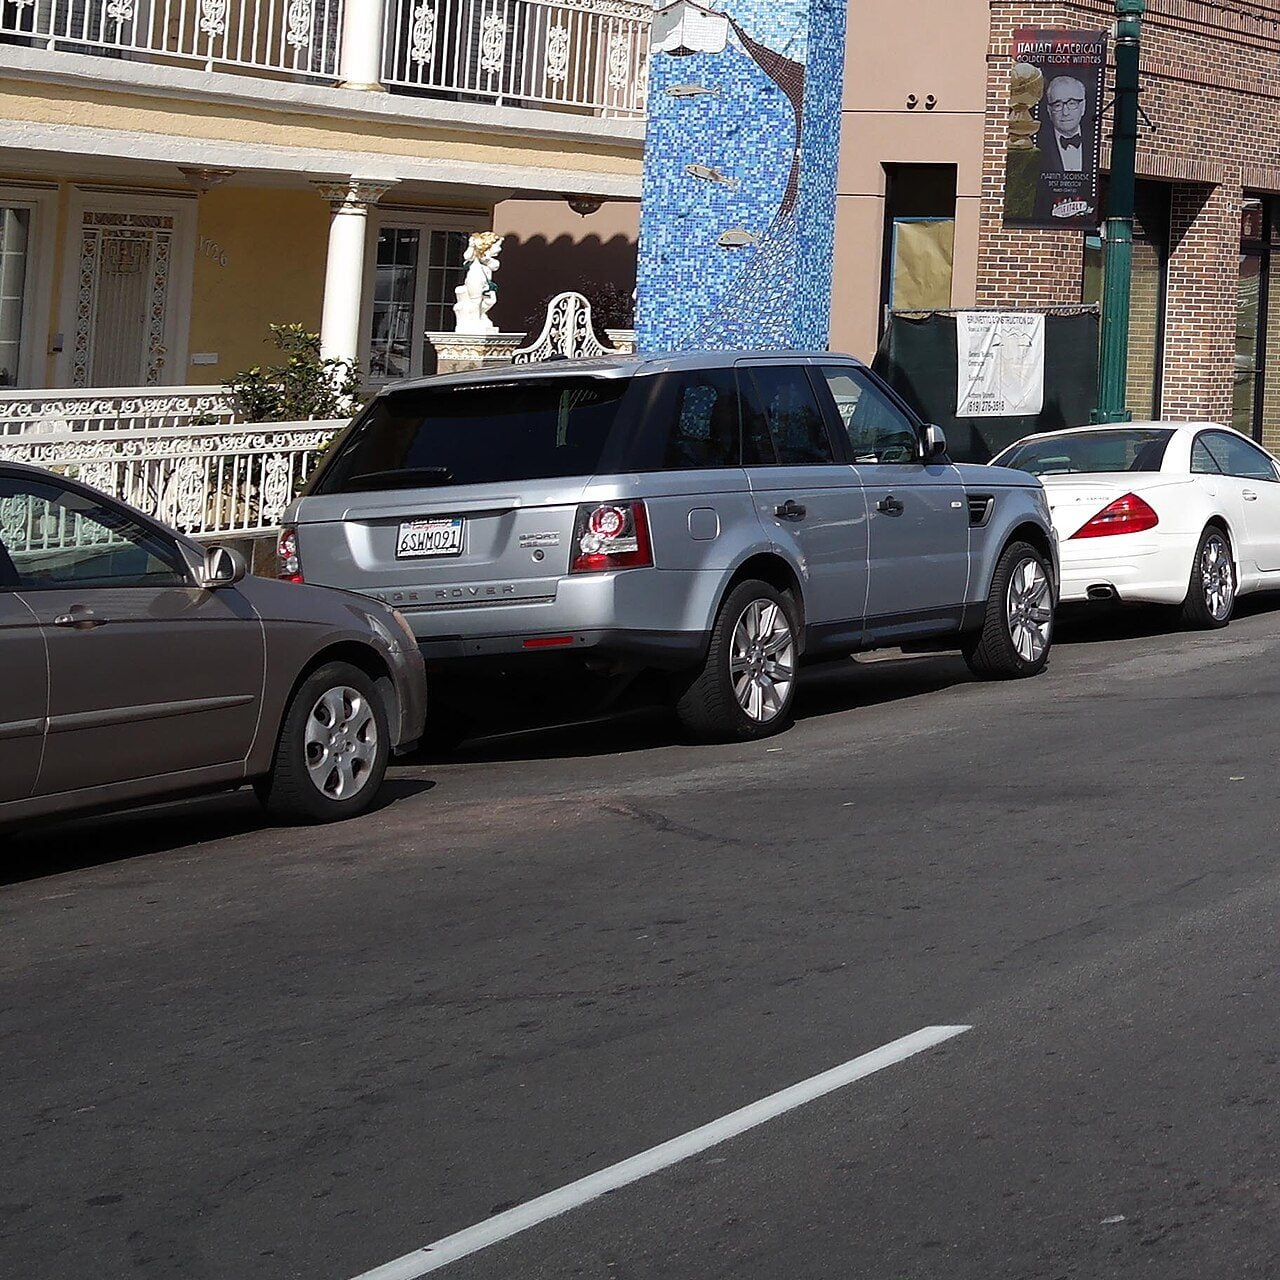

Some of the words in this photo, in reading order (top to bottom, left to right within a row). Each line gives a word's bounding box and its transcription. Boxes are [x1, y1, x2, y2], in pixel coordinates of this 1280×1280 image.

[1017, 42, 1052, 54] ITALIAN
[1055, 42, 1102, 54] AMERICAN
[1016, 55, 1045, 63] GOLDEN
[1047, 55, 1070, 63] GLOBE
[1072, 55, 1101, 64] WINNERS
[376, 591, 419, 601] NGE
[435, 584, 515, 599] ROVER
